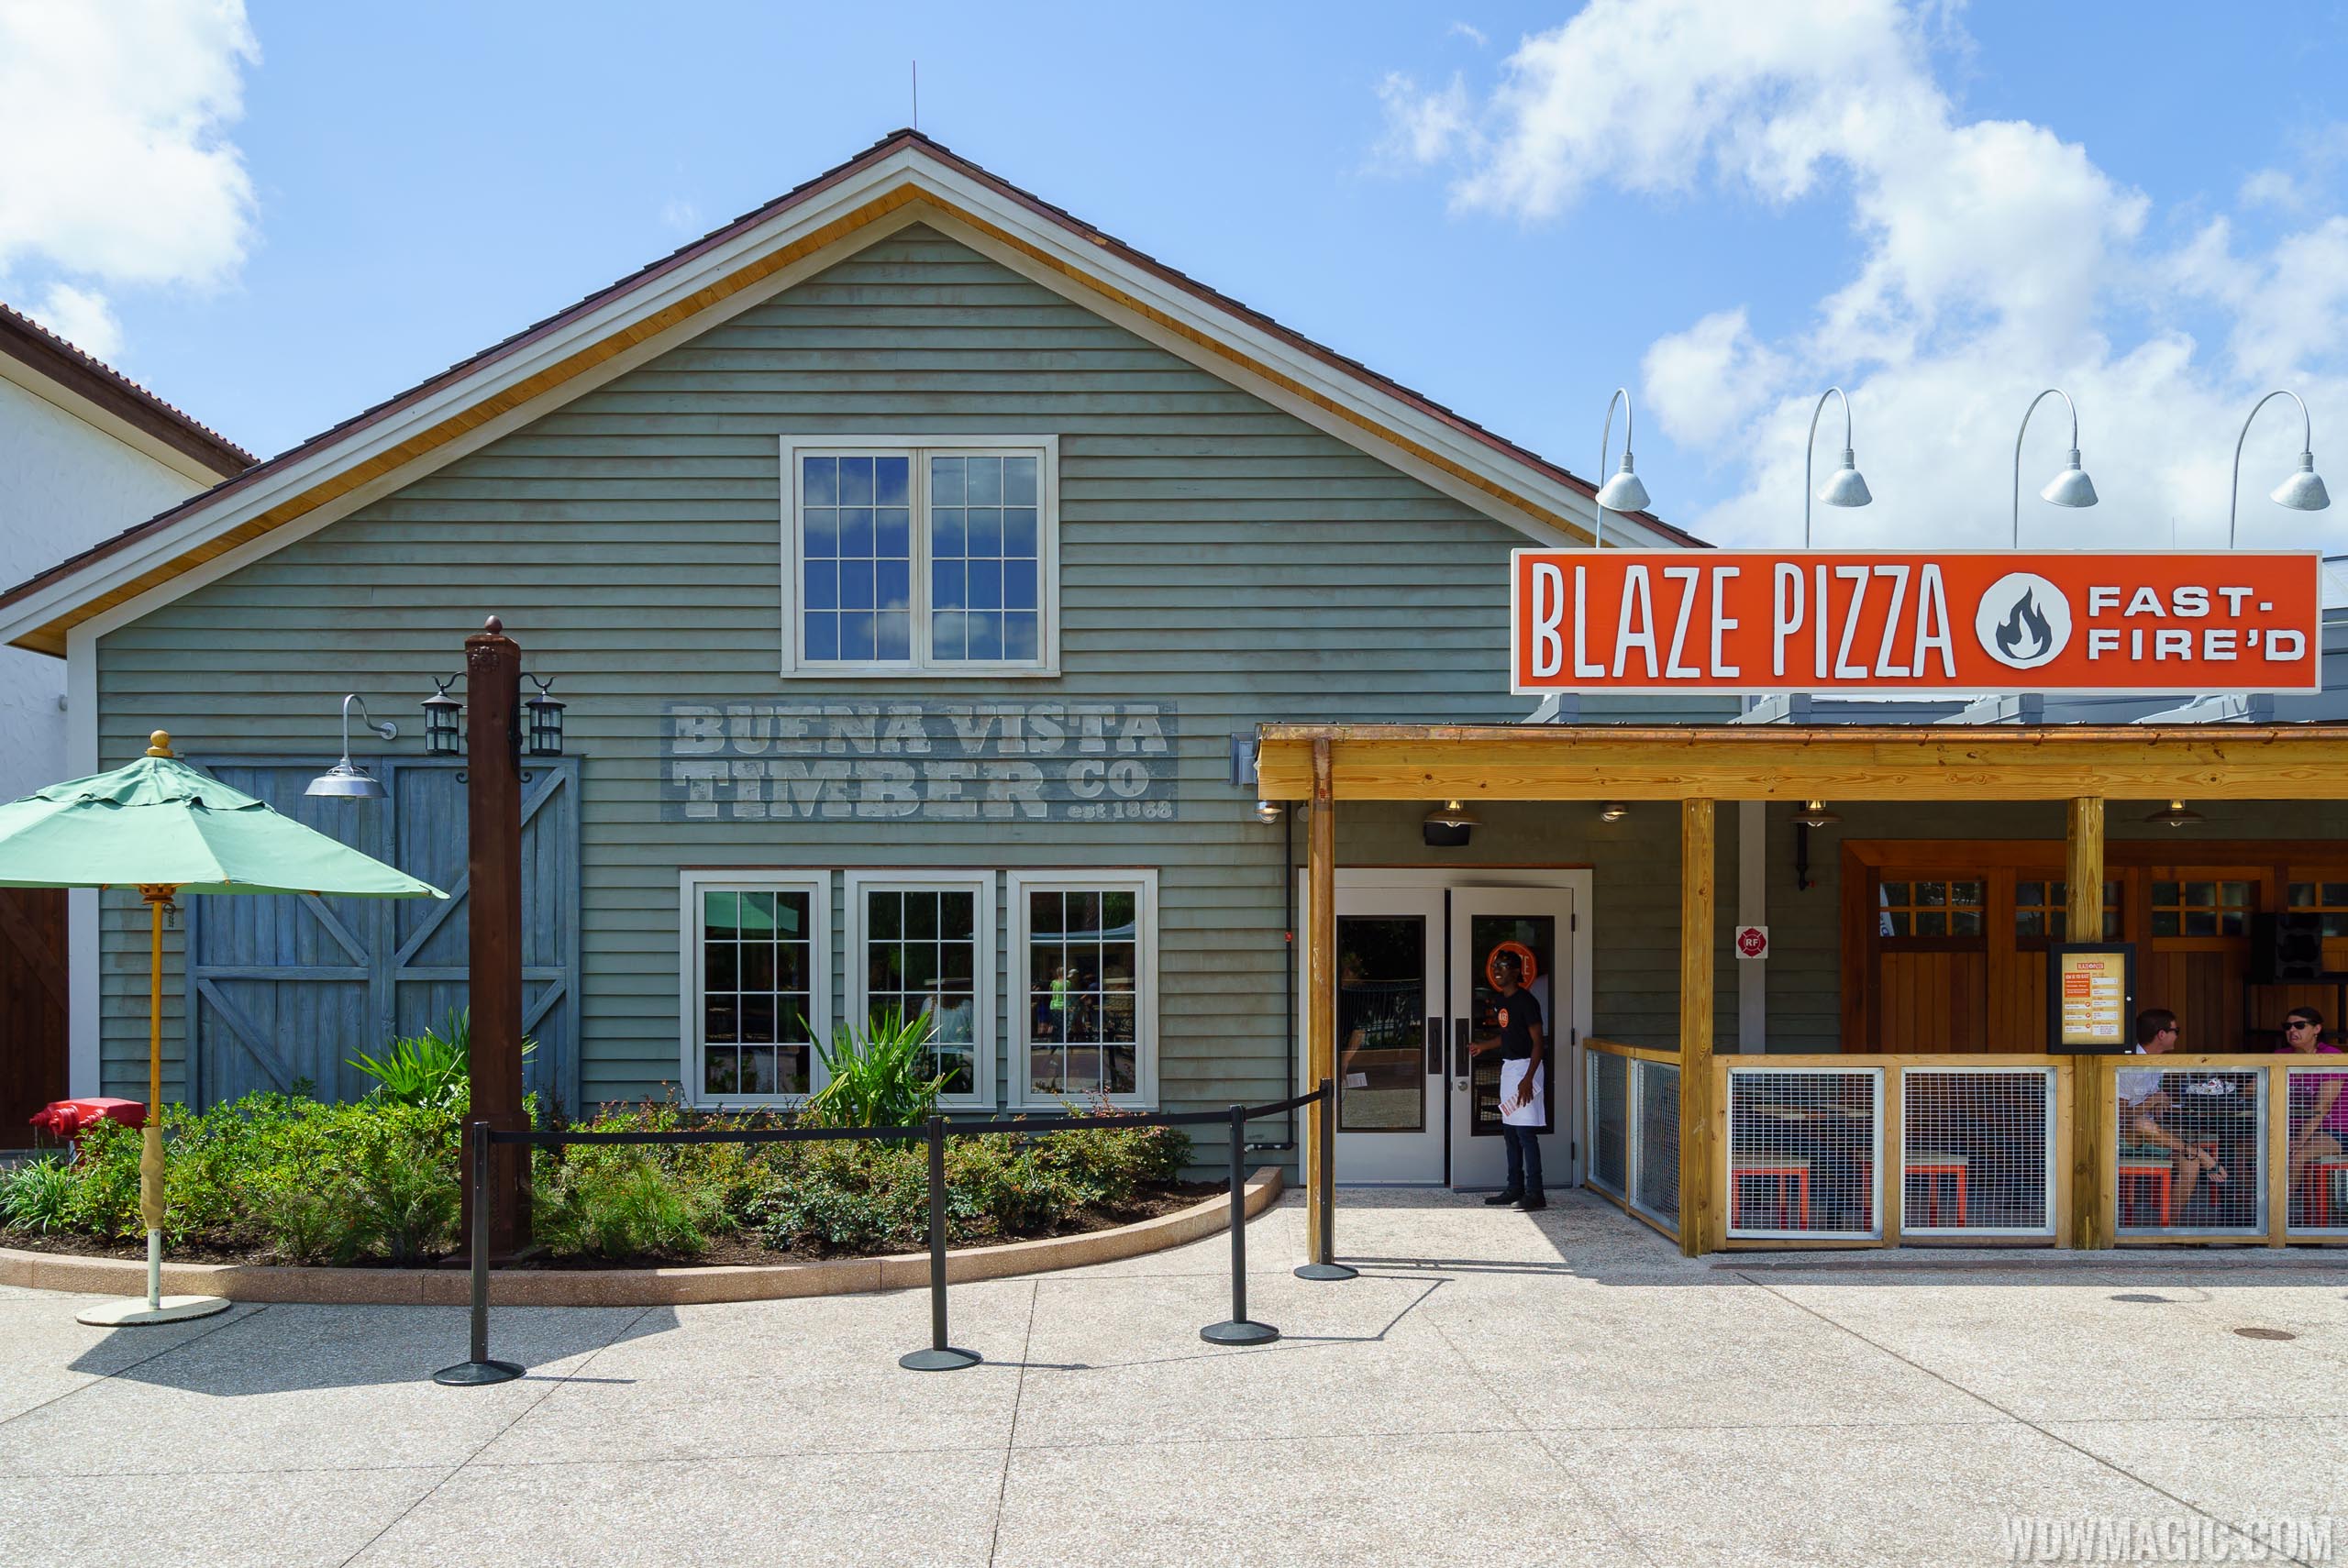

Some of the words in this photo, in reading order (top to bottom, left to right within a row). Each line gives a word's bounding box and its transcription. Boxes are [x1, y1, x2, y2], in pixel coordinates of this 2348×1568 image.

[2088, 586, 2274, 617] FAST-
[1532, 562, 1740, 679] BLAZE
[1774, 562, 1957, 679] PIZZA
[2088, 628, 2307, 661] FIRE'D
[670, 704, 931, 755] BUENA
[947, 703, 1168, 755] VISTA
[672, 760, 1048, 819] TIMBER
[1066, 759, 1150, 799] CO
[1067, 802, 1106, 819] est
[1113, 801, 1173, 819] 1868
[1745, 938, 1759, 946] RF
